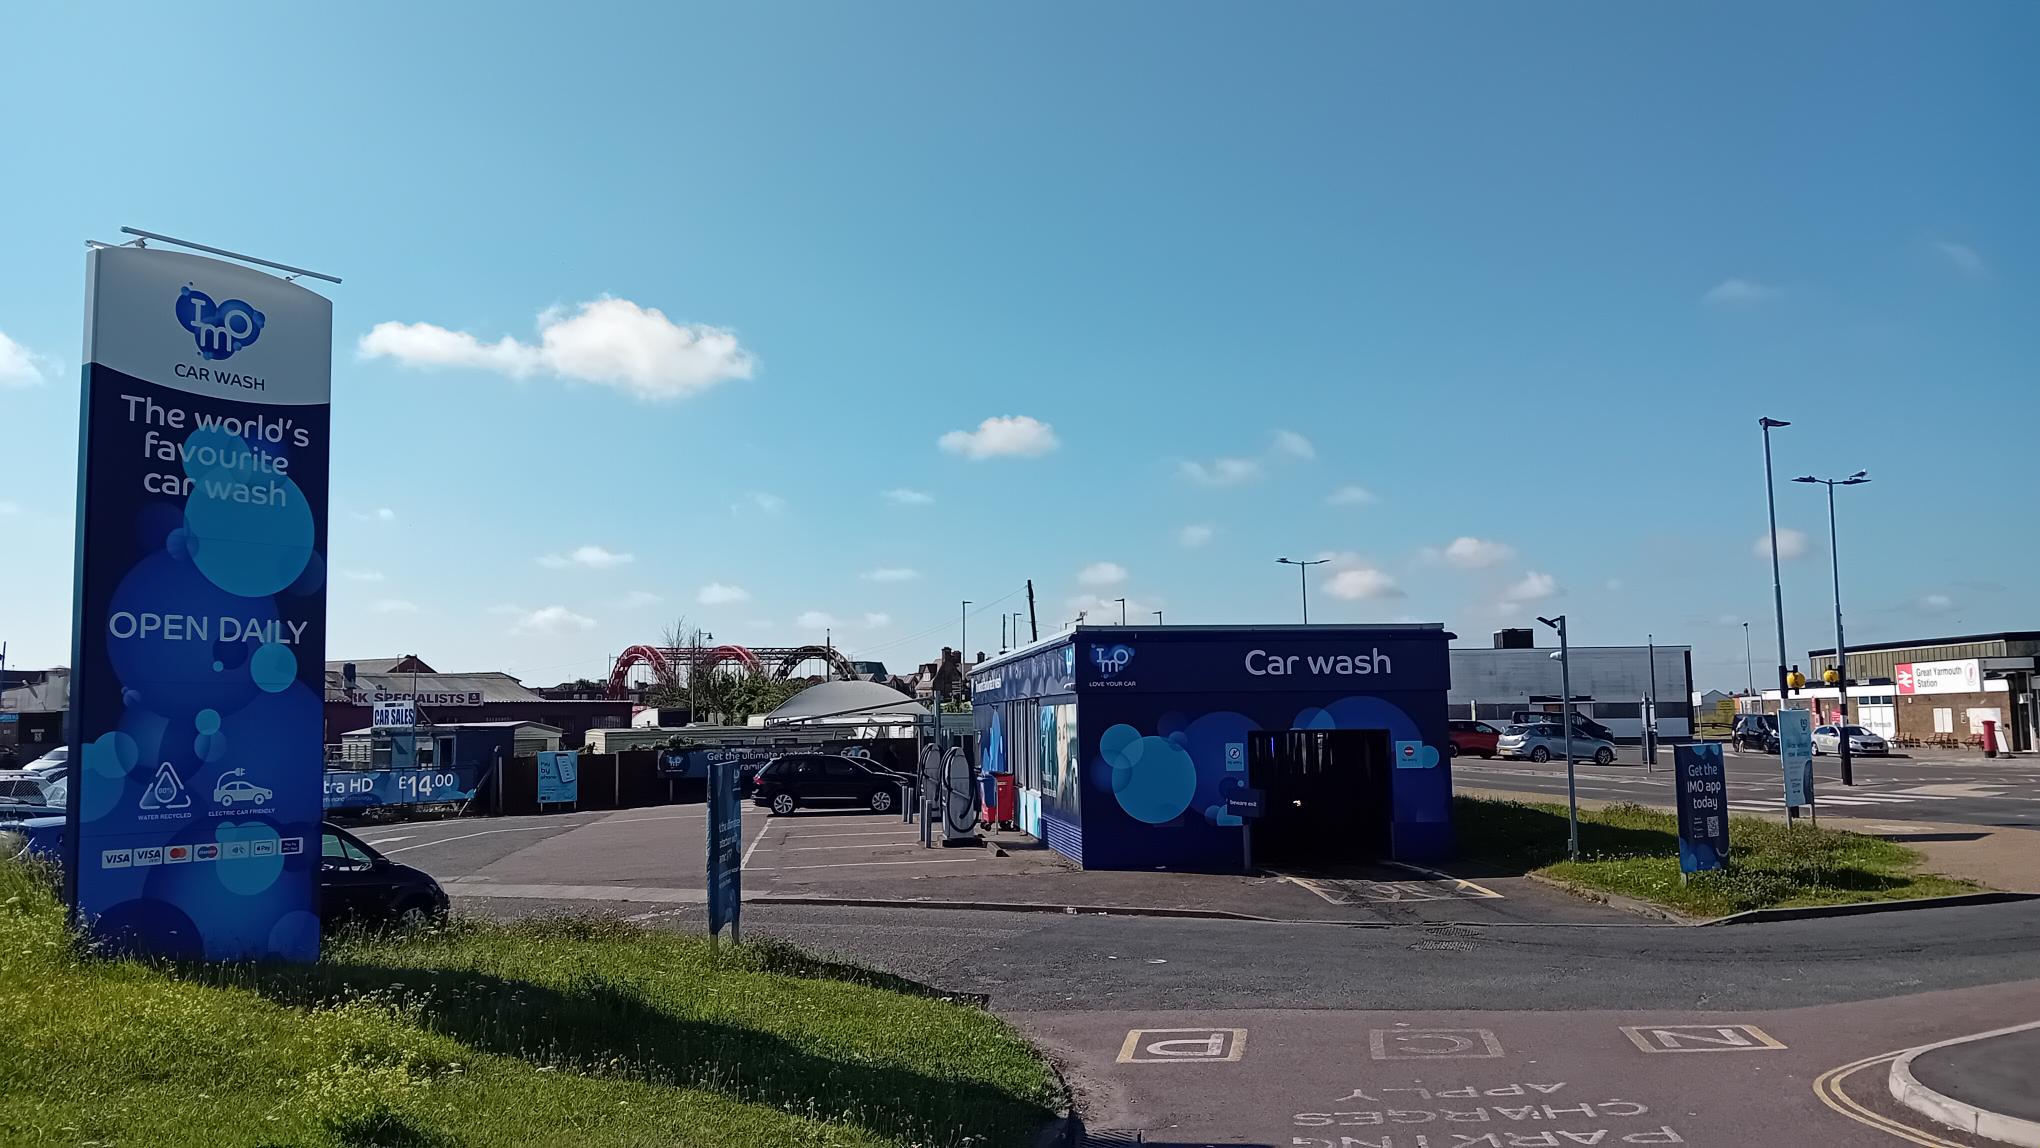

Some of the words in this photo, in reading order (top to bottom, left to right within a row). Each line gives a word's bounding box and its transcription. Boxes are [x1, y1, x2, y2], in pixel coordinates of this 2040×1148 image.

[174, 363, 210, 382] CAR
[214, 369, 265, 391] WASH
[120, 394, 185, 429] The
[194, 412, 310, 447] world's
[144, 431, 289, 475] favourite
[143, 472, 197, 497] car
[204, 480, 286, 507] wash
[109, 611, 208, 642] OPEN
[219, 616, 308, 645] DAILY
[1245, 649, 1300, 676] Car
[1307, 647, 1391, 675] wash
[1917, 667, 1932, 677] Great
[1934, 665, 1962, 676] Yarmouth
[1917, 679, 1938, 688] Station
[374, 692, 465, 704] SPECIALISTS
[374, 709, 390, 726] CAR
[390, 708, 414, 726] SALES
[707, 752, 723, 761] Get
[725, 751, 740, 761] the
[742, 750, 779, 760] ultimate
[1688, 764, 1703, 777] Get
[1704, 763, 1718, 776] the
[350, 777, 373, 793] HD
[399, 773, 453, 798] £14.00
[1687, 780, 1704, 793] IMO
[1705, 781, 1721, 794] app
[1693, 796, 1718, 810] today
[160, 812, 192, 820] RECYCLED
[208, 809, 236, 817] ELECTRIC
[105, 853, 131, 864] VISA
[136, 849, 161, 859] VISA
[1335, 1082, 1567, 1101] APPLY
[1292, 1101, 1649, 1126] CHARGES
[1291, 1125, 1684, 1148] PARKING
